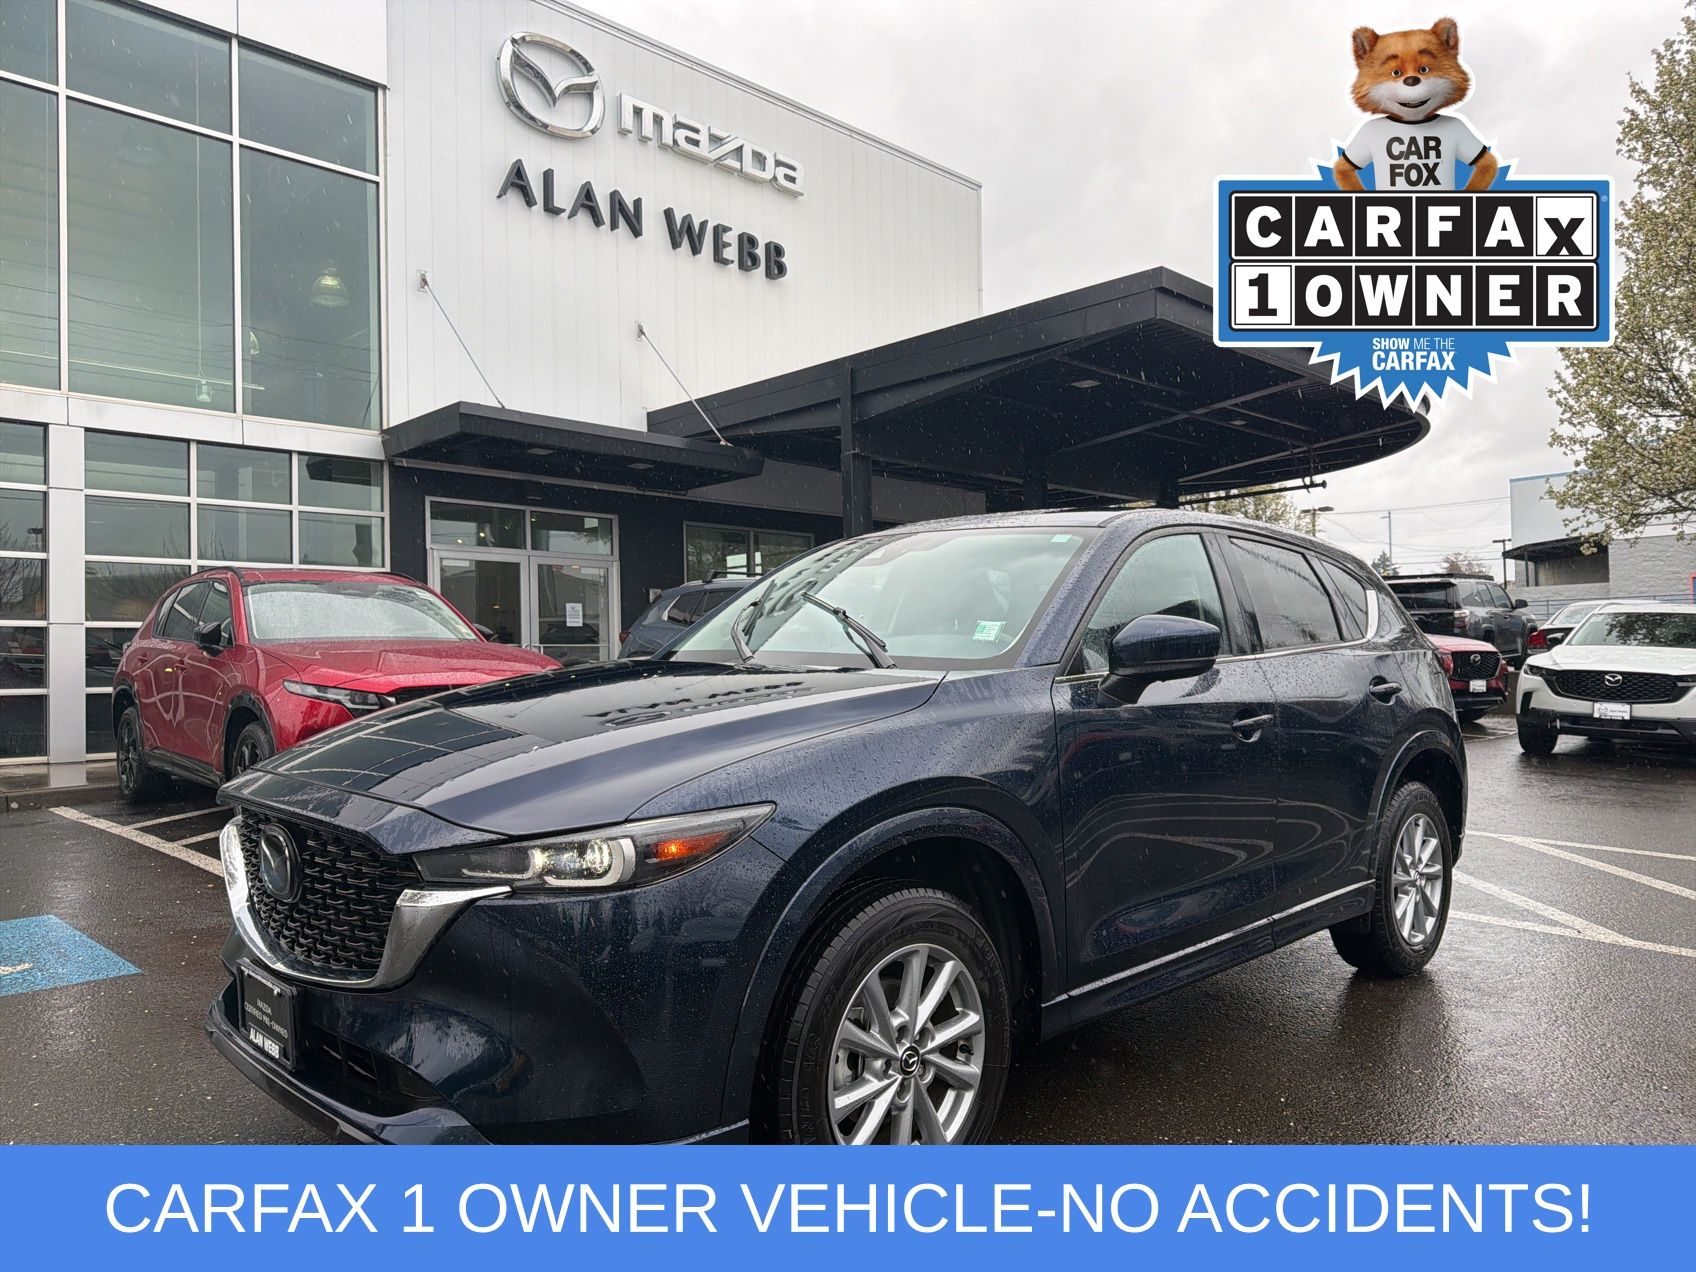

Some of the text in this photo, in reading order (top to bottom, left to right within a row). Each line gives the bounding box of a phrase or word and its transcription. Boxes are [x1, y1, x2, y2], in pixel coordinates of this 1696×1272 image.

[496, 158, 788, 281] ALAN WEBB
[250, 1028, 280, 1059] ALAN WEBB
